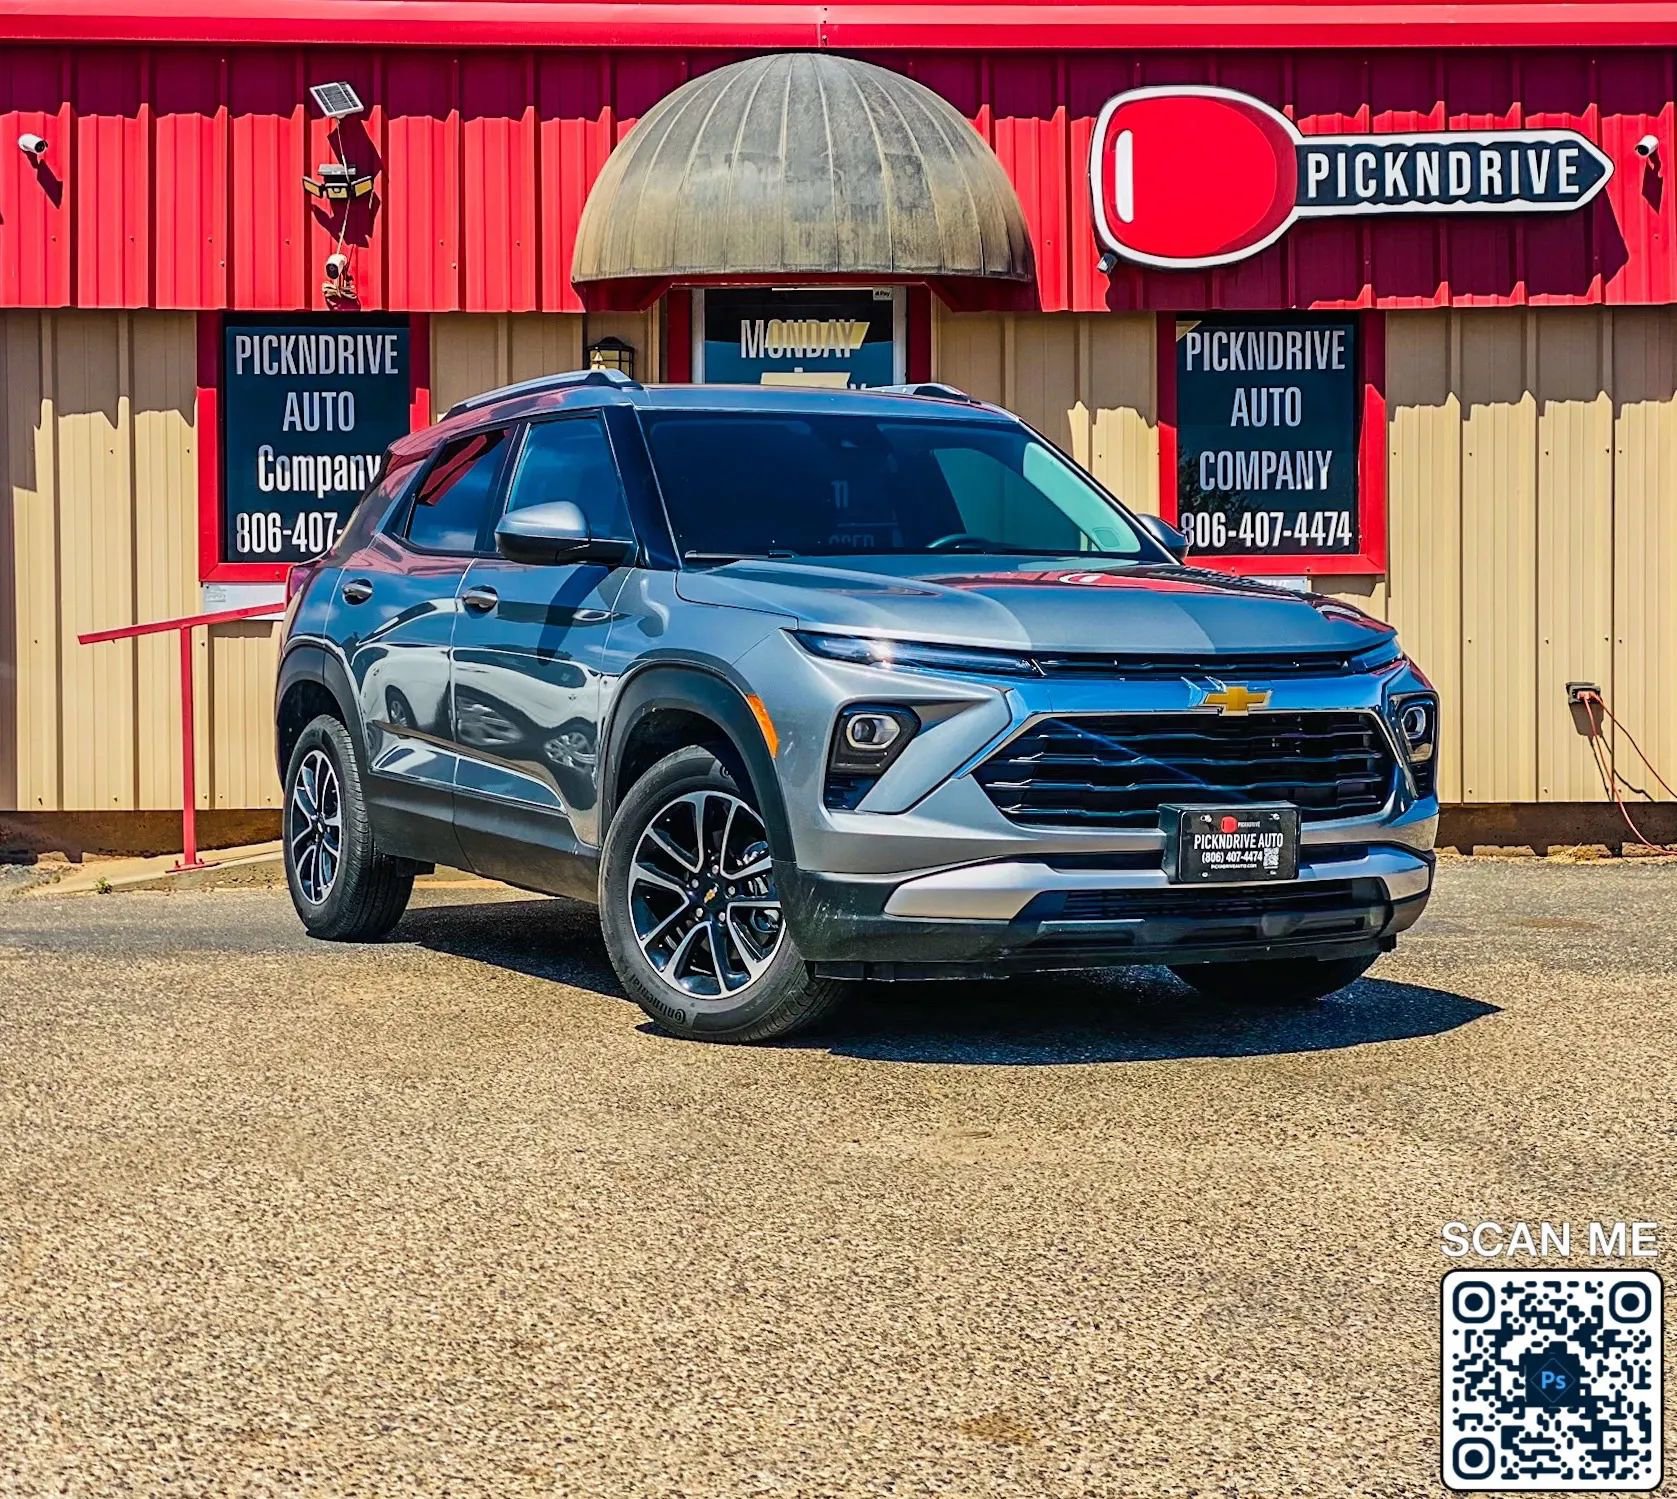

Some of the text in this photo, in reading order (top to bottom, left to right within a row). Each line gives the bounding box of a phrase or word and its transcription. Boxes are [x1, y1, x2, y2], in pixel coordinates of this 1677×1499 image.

[1307, 148, 1580, 198] PICKNDRIVE
[235, 334, 399, 375] PICKNDRIVE
[740, 318, 857, 359] MONDAY
[1185, 330, 1346, 372] PICKNDRIVE
[282, 390, 355, 432] AUTO
[1230, 386, 1302, 427] AUTO
[1200, 450, 1333, 491] COMPANY
[1180, 511, 1353, 548] 806-407-4474
[1193, 832, 1284, 850] PICKNDRIVE AUTO
[1201, 850, 1263, 864] (806) 407-4474
[629, 973, 687, 1025] Continental
